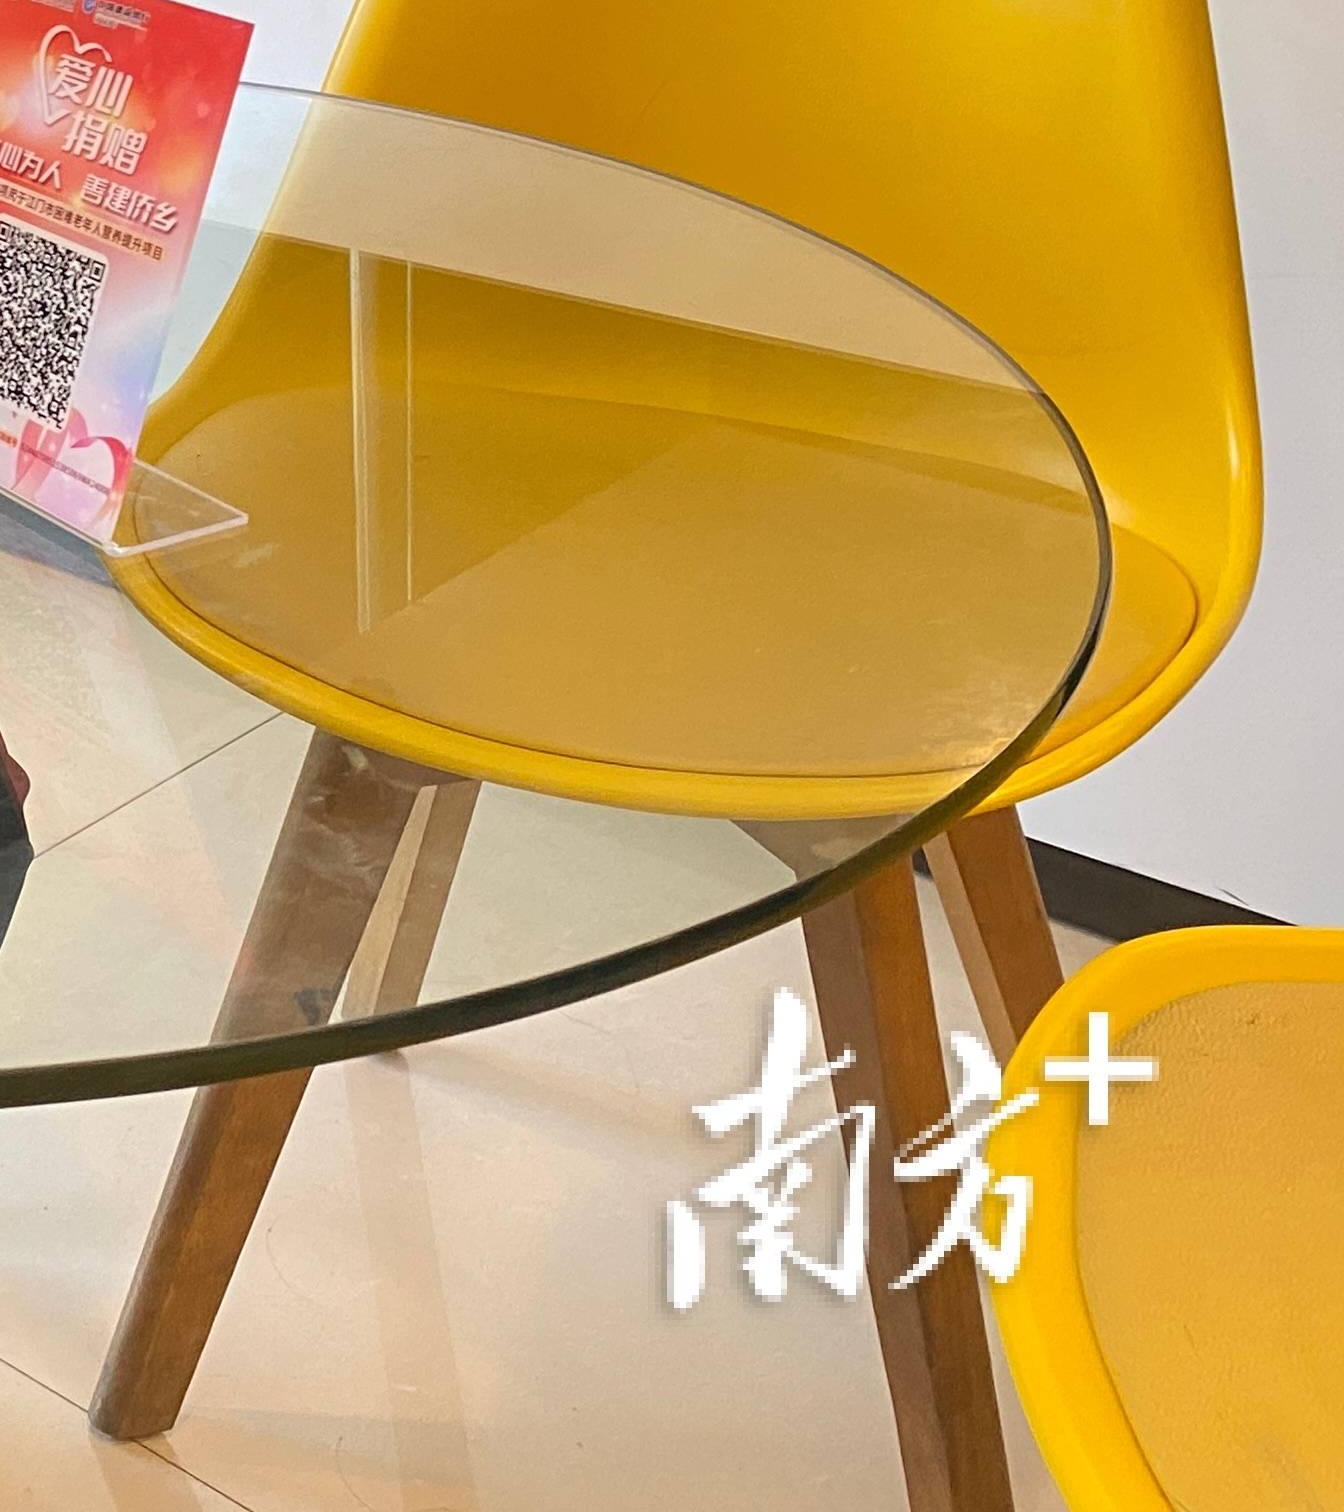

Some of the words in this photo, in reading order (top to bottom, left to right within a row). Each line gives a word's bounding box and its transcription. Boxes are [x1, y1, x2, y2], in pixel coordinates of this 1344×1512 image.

[48, 54, 134, 117] 爱心
[62, 110, 147, 176] 捐赠
[80, 174, 179, 233] 善建侨乡
